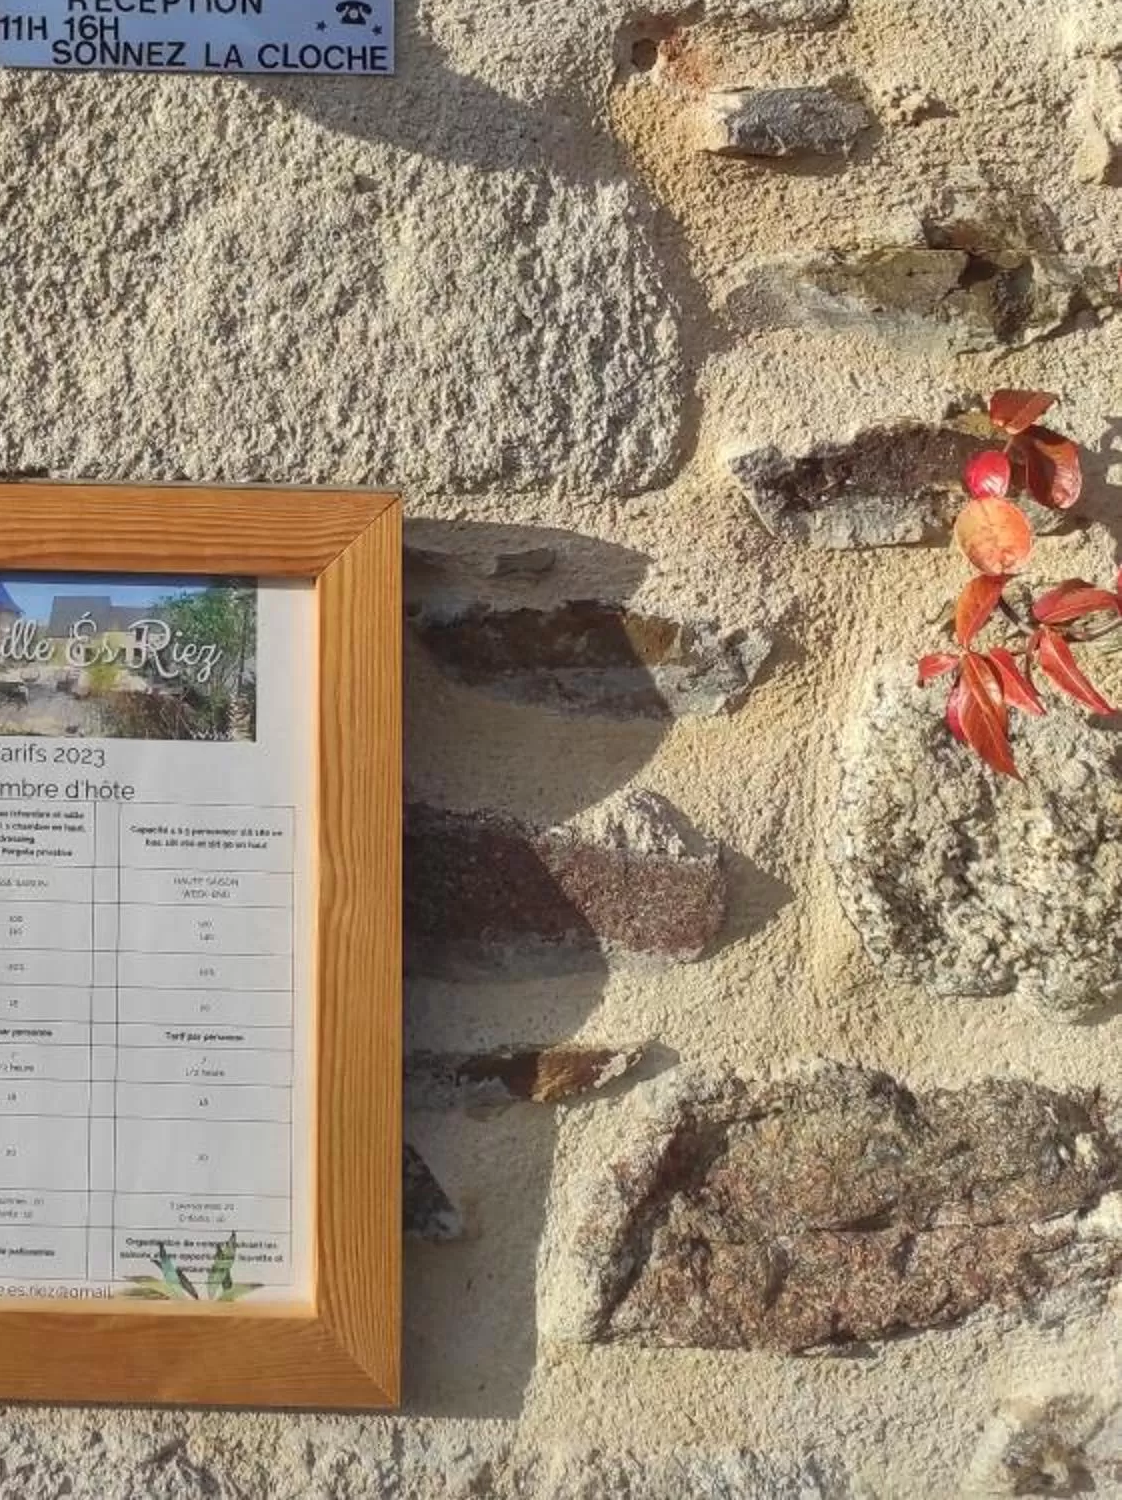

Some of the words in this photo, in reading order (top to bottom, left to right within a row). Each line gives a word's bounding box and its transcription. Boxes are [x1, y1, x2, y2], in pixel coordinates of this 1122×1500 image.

[63, 16, 119, 41] 16H
[52, 40, 187, 67] SONNEZ
[205, 43, 244, 69] LA
[257, 44, 388, 71] CLOCHE
[126, 619, 224, 683] Riez
[53, 747, 106, 768] 2023
[65, 778, 136, 800] d'hôte
